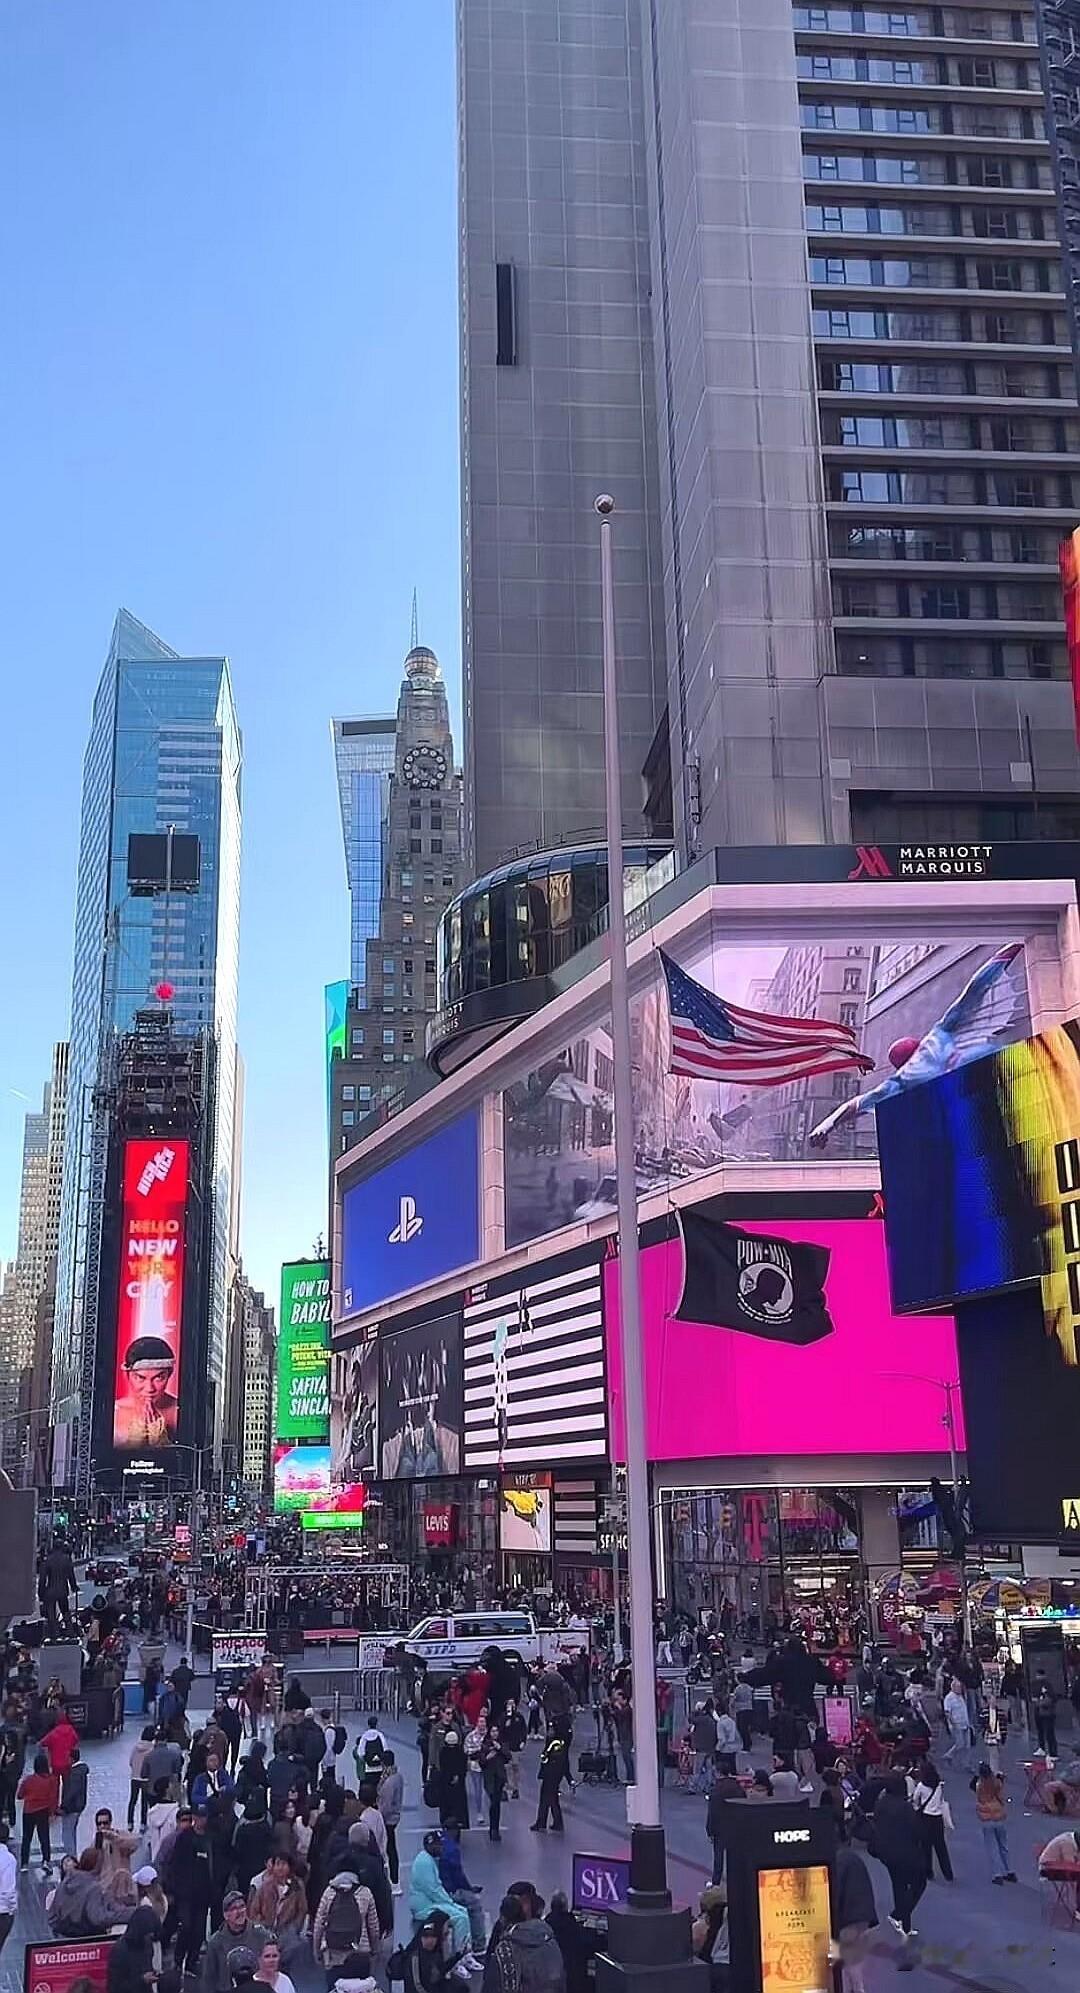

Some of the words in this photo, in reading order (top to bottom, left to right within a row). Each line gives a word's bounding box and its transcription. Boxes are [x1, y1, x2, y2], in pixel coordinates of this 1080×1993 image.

[900, 846, 993, 859] MARRIOTT
[901, 861, 984, 874] MARQUIS
[129, 1219, 180, 1234] HELLO
[128, 1239, 178, 1256] NEW
[737, 1239, 763, 1269] POW
[768, 1243, 793, 1281] MIA
[291, 1281, 316, 1299] HOW
[317, 1279, 330, 1296] TO
[289, 1376, 327, 1396] SAFIYA
[214, 1639, 265, 1649] CHICAGO
[774, 1830, 810, 1843] HOPE
[34, 1949, 101, 1965] Welcome!
